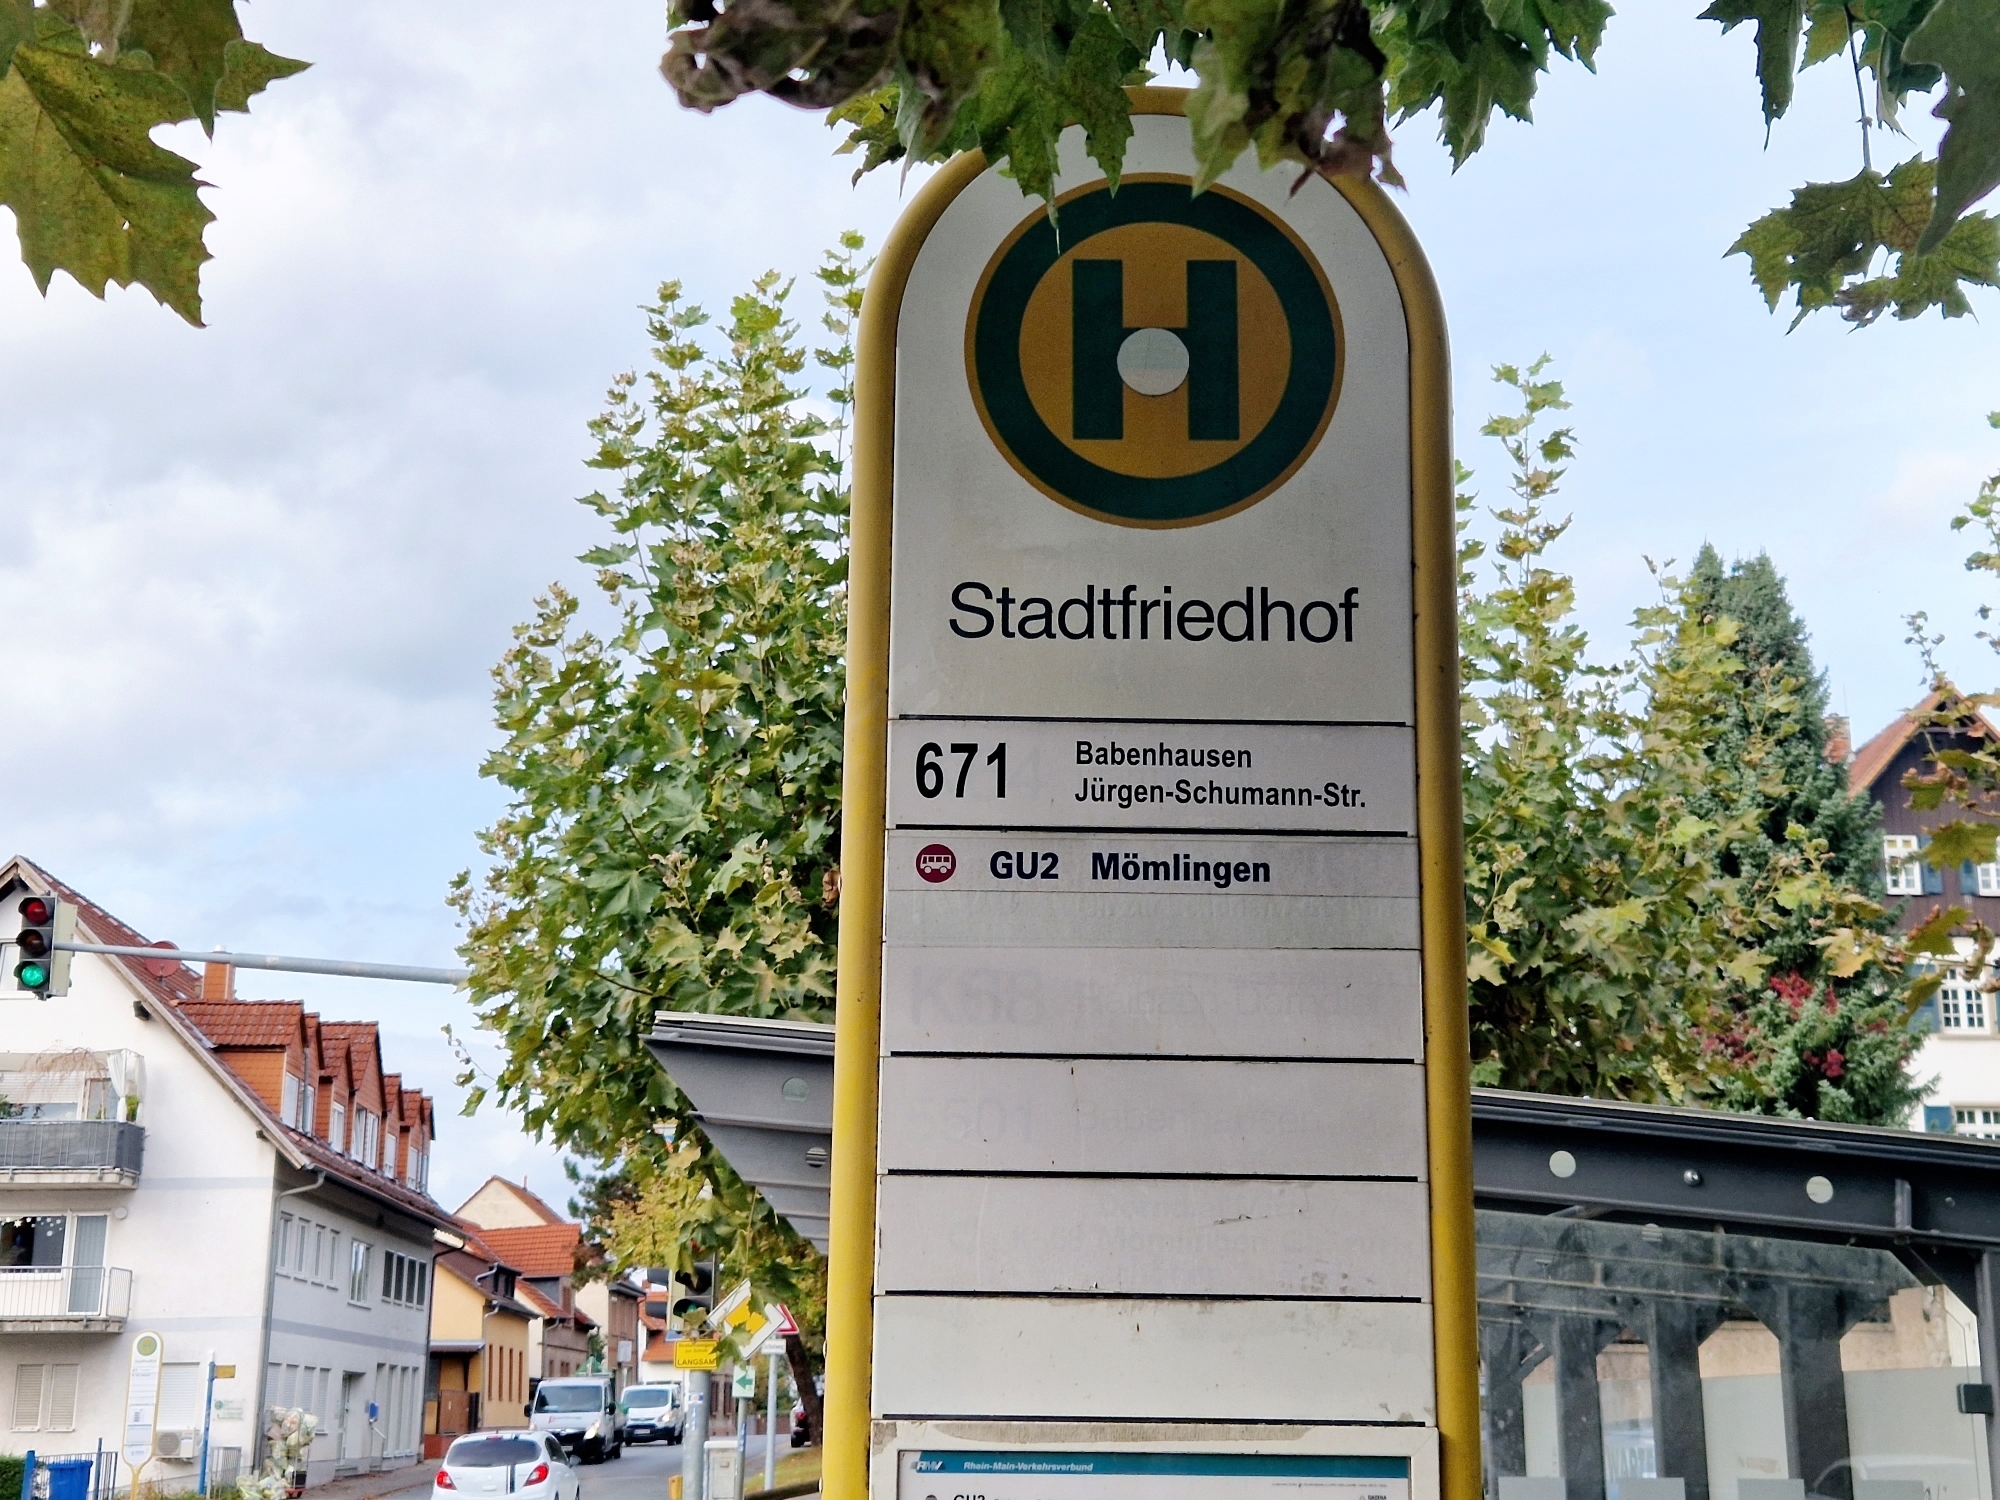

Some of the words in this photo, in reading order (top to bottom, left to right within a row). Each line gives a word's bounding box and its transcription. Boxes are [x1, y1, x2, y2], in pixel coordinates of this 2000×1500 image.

[1072, 258, 1240, 441] H
[949, 581, 1360, 644] Stadtfriedhof
[915, 742, 1008, 799] 671
[1076, 741, 1252, 768] Babenhausen
[1075, 778, 1366, 809] Jürgen-Schumann-Str.
[989, 851, 1060, 880] GU2
[1091, 852, 1271, 889] Mömlingen
[963, 1461, 1095, 1472] Rhein-Main-Verkehrsverbund
